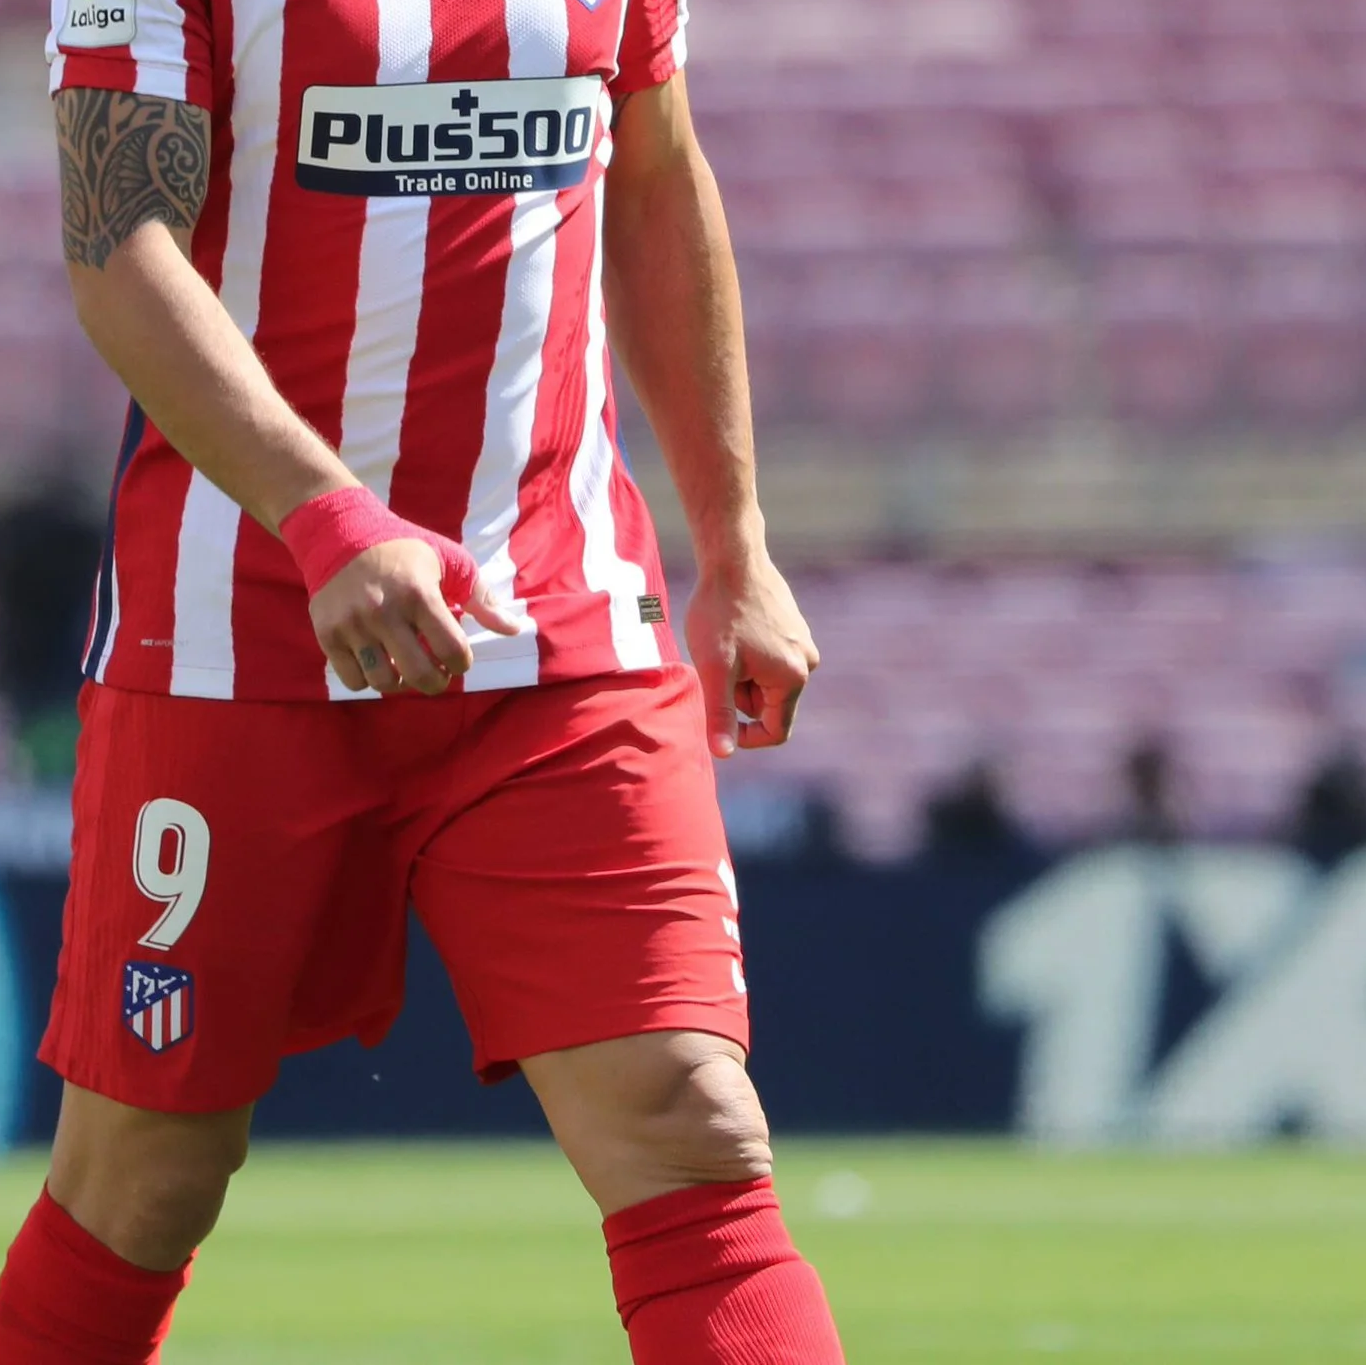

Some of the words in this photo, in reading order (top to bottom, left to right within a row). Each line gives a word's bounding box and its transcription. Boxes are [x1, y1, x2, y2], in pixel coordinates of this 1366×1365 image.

[310, 107, 591, 163] Plus500
[395, 174, 456, 192] Trade
[465, 172, 533, 191] Online
[133, 797, 211, 951] 9
